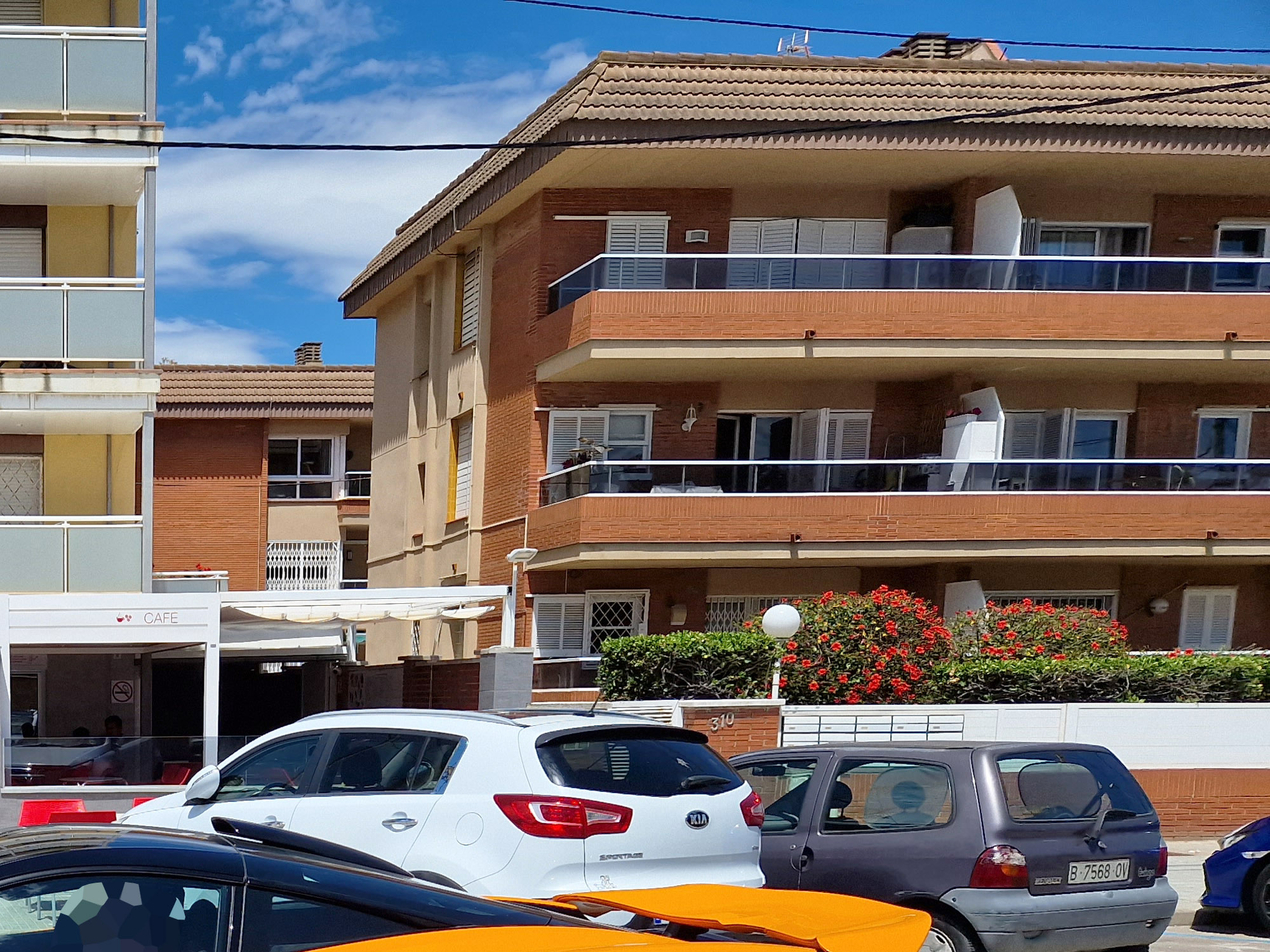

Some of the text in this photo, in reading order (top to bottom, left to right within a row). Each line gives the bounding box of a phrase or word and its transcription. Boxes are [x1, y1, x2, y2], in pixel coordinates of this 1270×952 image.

[143, 612, 179, 624] CAFE
[709, 712, 735, 731] 310
[689, 814, 707, 825] KIA
